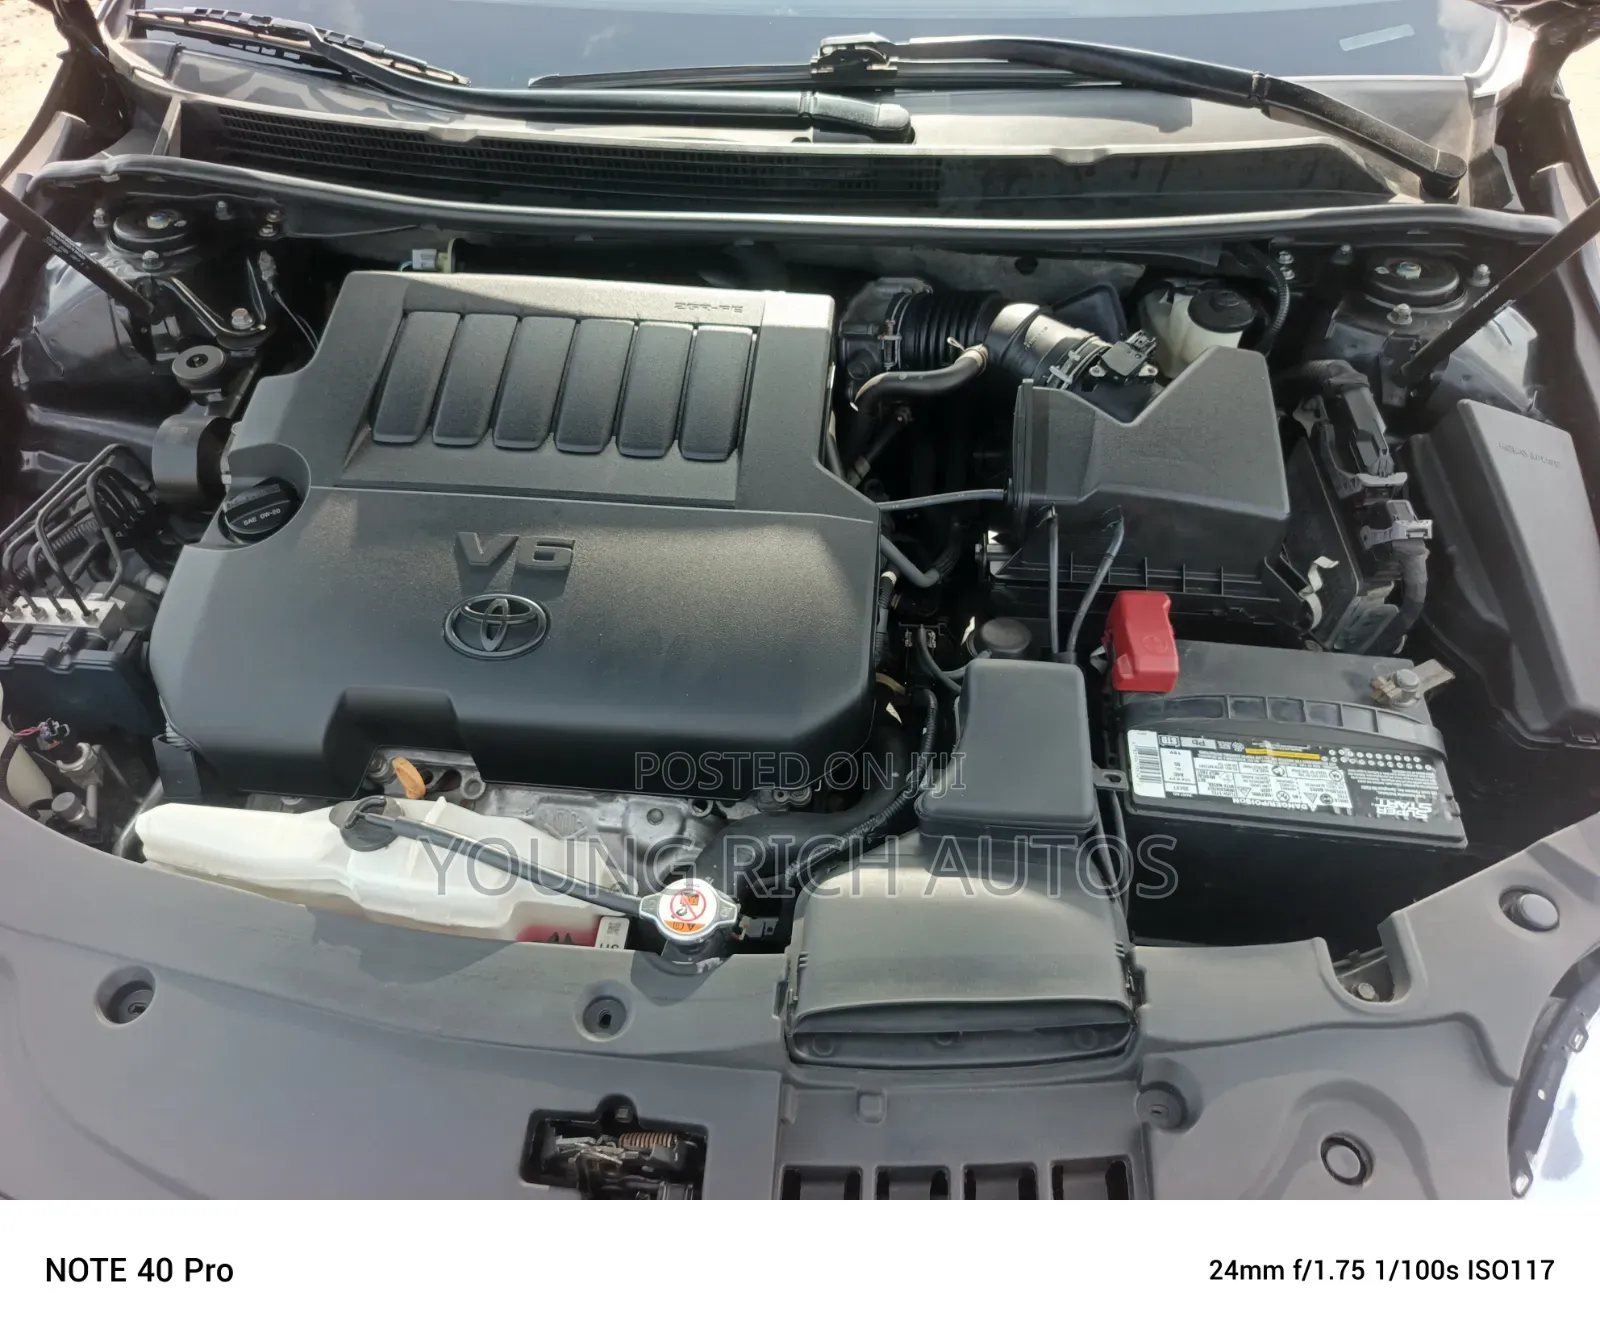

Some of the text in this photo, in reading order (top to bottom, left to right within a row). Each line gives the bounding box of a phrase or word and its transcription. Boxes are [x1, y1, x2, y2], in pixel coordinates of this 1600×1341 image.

[243, 508, 281, 527] SAE 0W-20
[455, 531, 575, 570] V6
[1232, 798, 1309, 811] DANGER/POISON
[1374, 799, 1432, 813] START
[1376, 807, 1428, 819] SUPER
